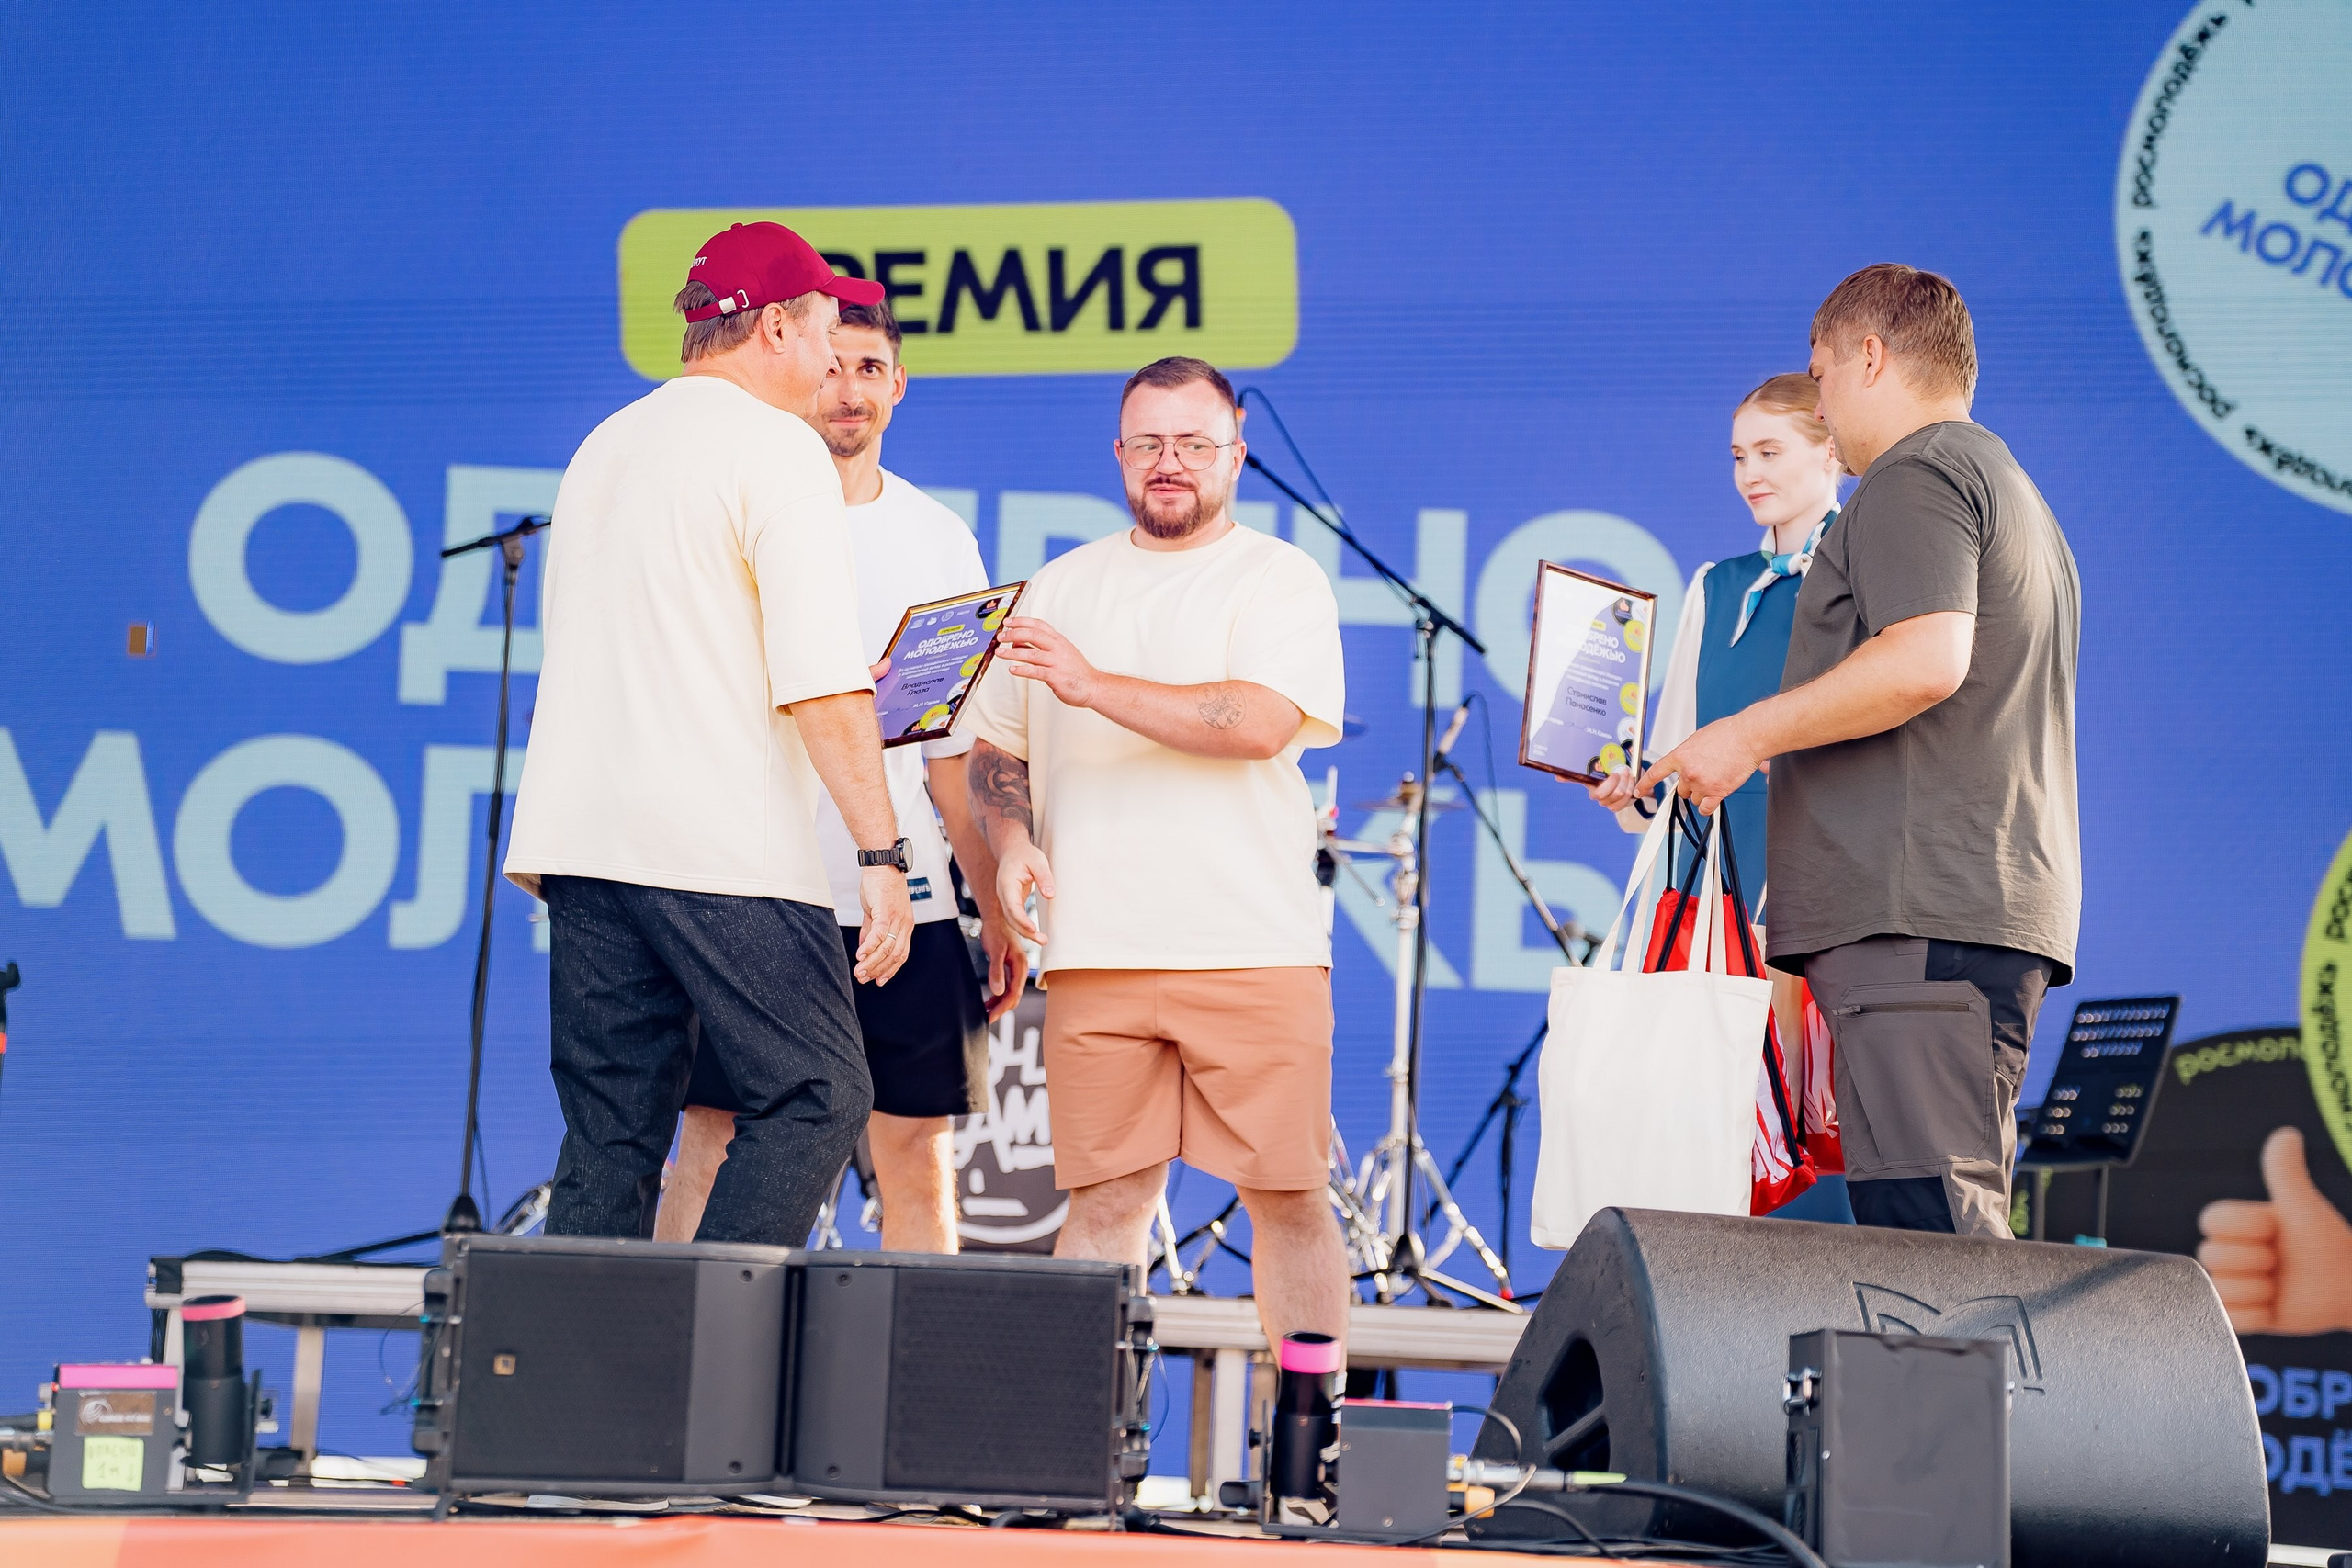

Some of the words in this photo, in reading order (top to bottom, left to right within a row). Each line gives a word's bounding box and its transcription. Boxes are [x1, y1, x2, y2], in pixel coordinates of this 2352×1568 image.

[917, 629, 975, 649] ОДОБРЕНО
[901, 677, 944, 691] Владислав
[907, 687, 930, 697] Гроза
[1566, 686, 1607, 705] Станислав
[1566, 696, 1607, 716] Панасенко
